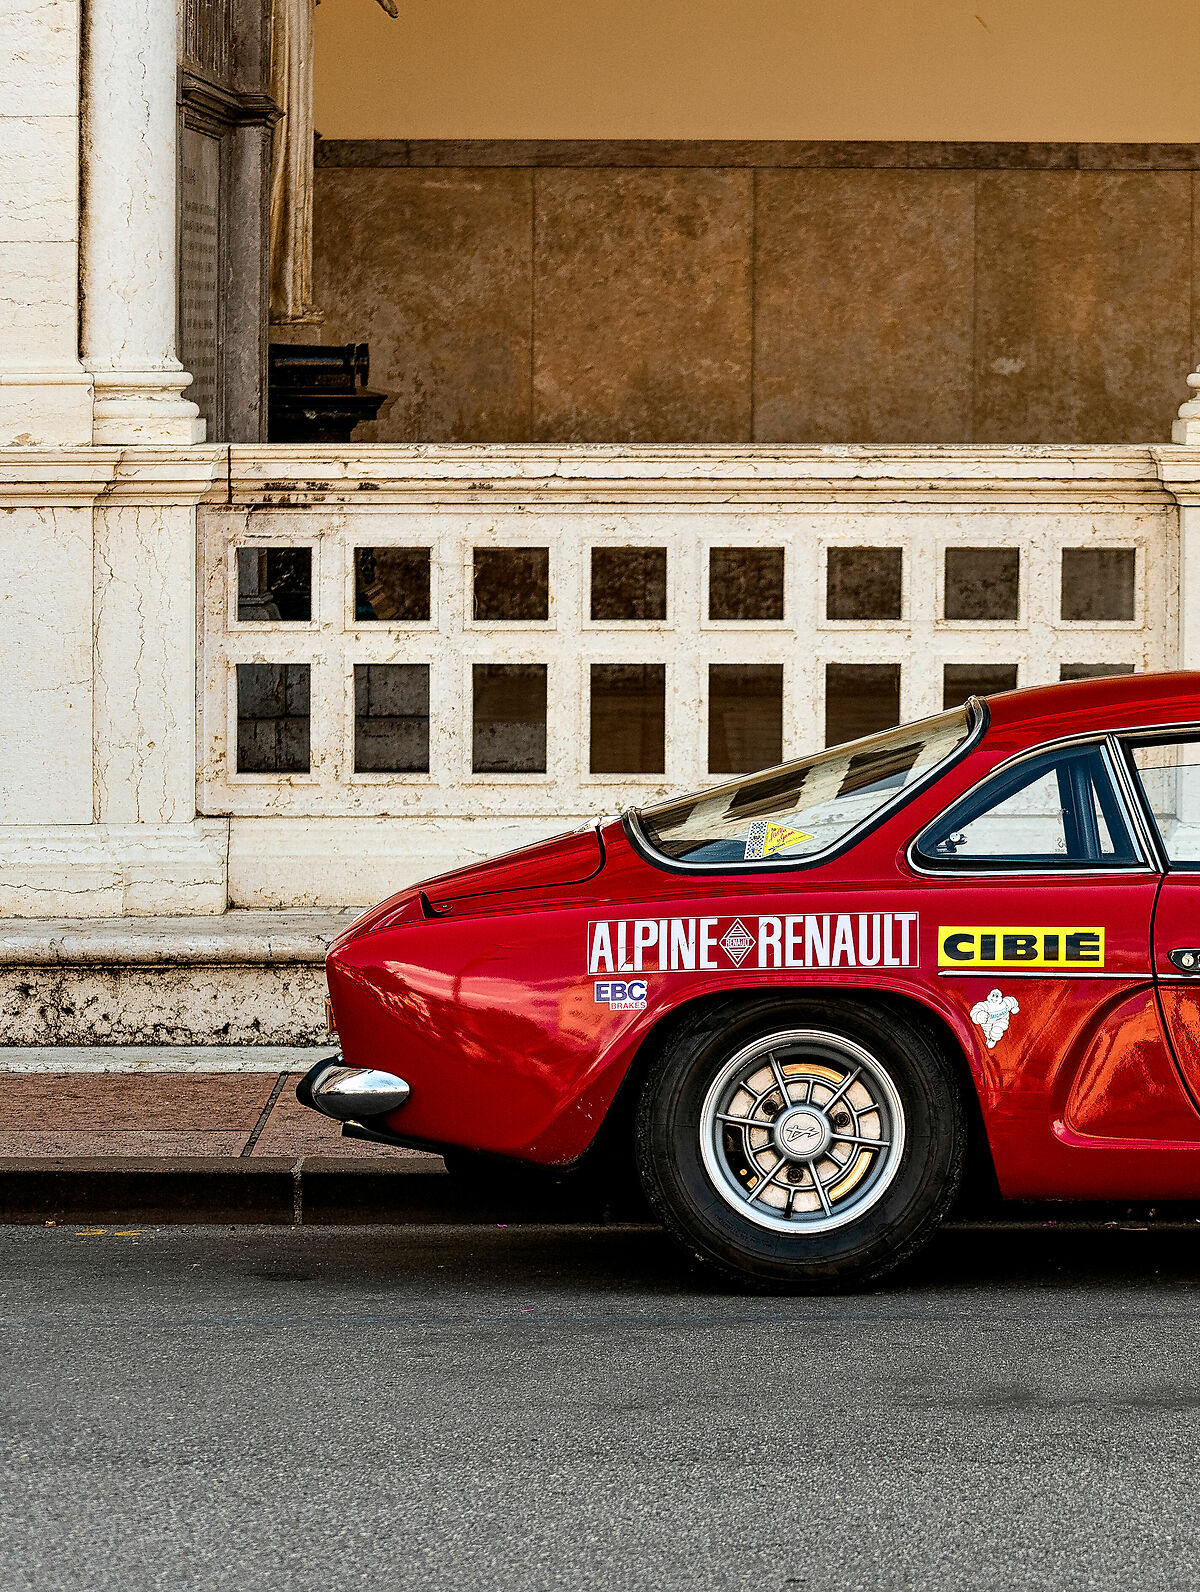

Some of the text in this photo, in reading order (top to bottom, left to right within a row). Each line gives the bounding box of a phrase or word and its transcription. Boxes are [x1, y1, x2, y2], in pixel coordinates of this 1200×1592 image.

[589, 913, 917, 973] ALPINE RENAULT
[725, 938, 750, 947] RENAULT
[595, 981, 647, 1002] EBC
[610, 1001, 646, 1010] BRAKES
